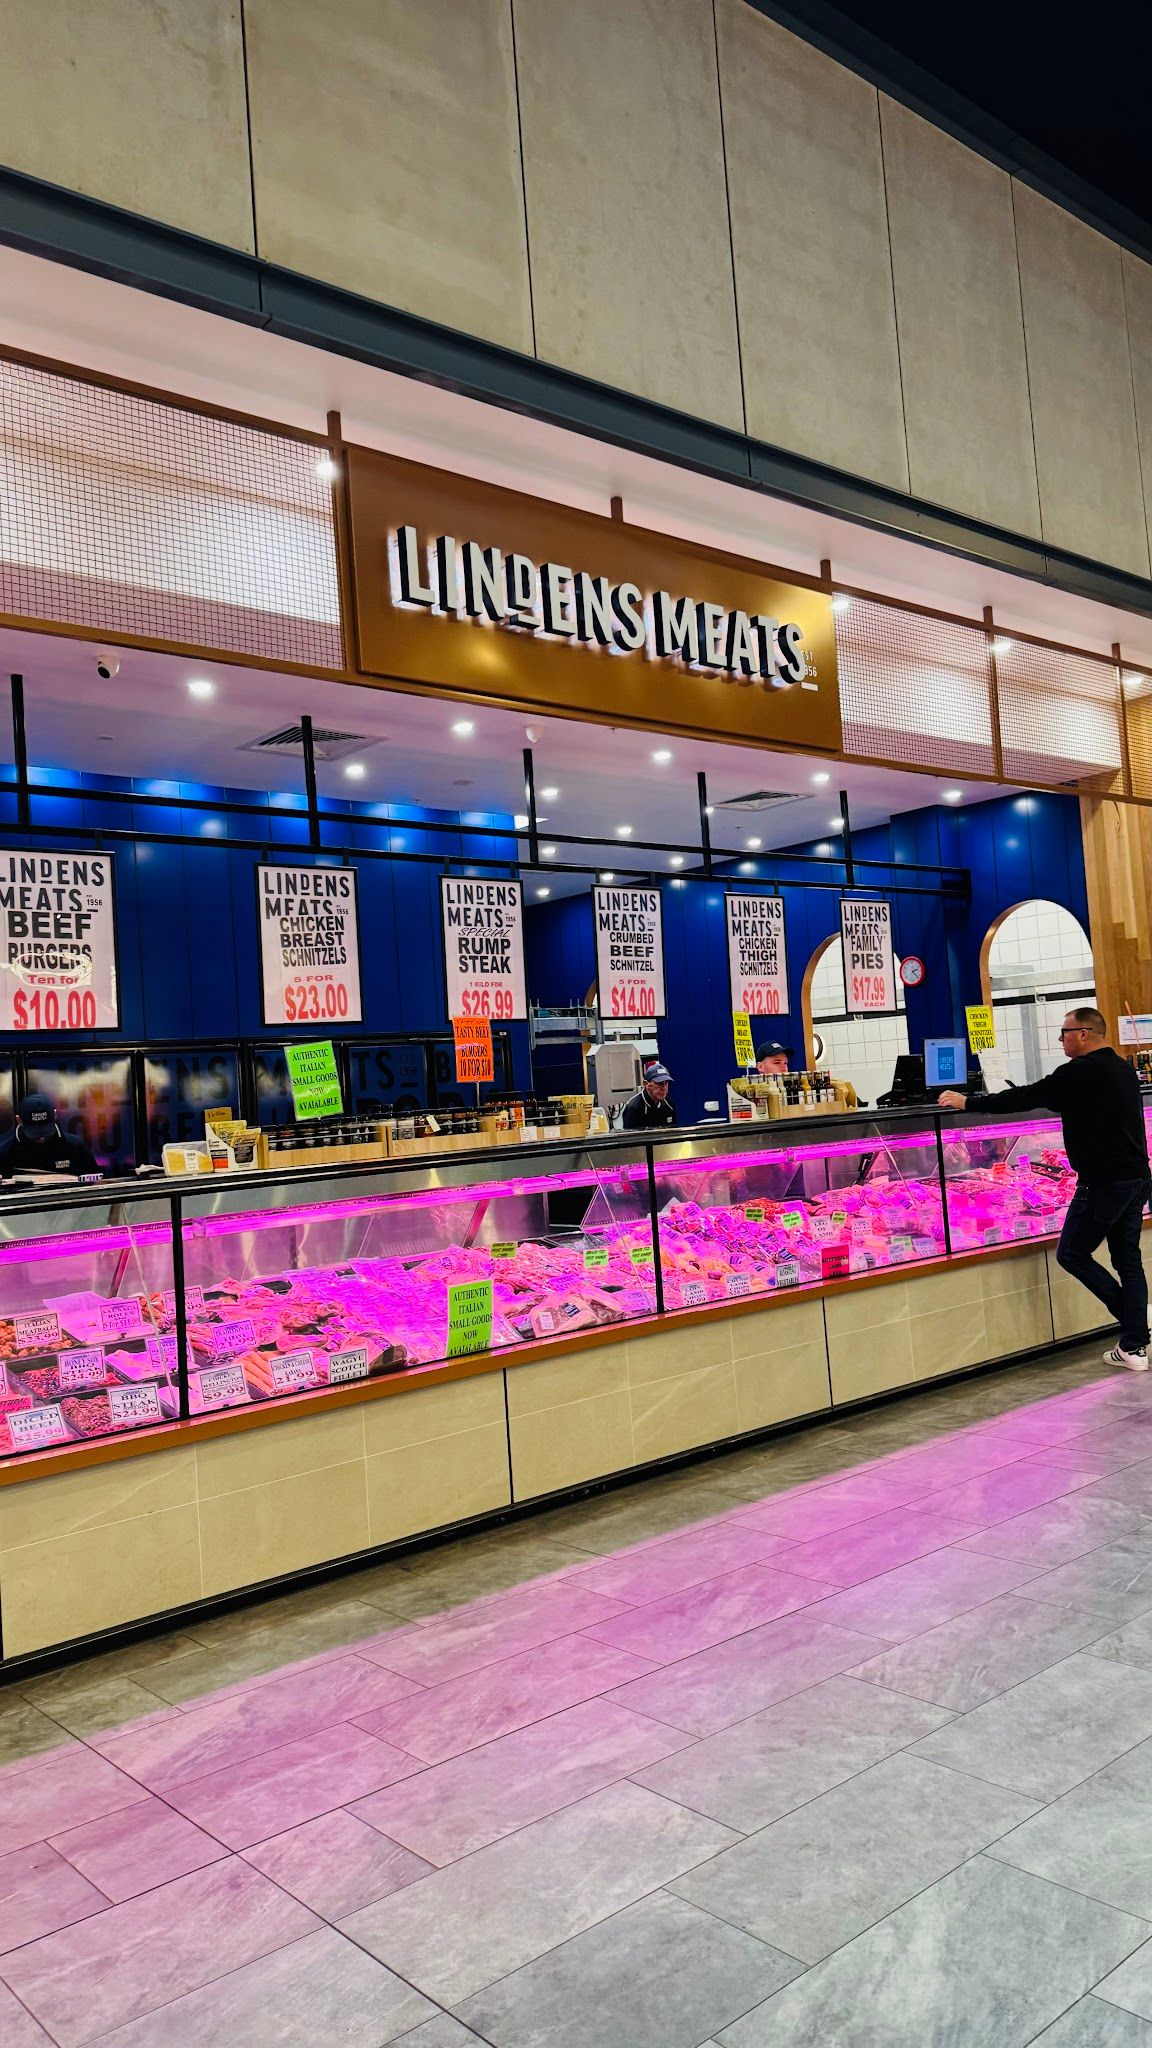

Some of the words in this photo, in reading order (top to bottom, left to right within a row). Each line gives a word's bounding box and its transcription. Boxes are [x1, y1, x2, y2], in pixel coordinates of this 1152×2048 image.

[397, 525, 646, 651] LINDENS
[653, 591, 805, 684] MEATS
[0, 857, 105, 887] INDENS
[264, 872, 350, 898] LINDENS
[446, 884, 517, 907] LINDENS
[598, 892, 657, 912] LINDENS
[265, 897, 333, 919] MEATS
[731, 900, 781, 918] LINDENS
[843, 905, 888, 922] LINDENS
[279, 916, 345, 932] CHICKEN
[447, 907, 504, 928] MEATS
[599, 913, 646, 932] MEATS
[7, 911, 92, 940] BEEF
[458, 928, 511, 937] SPECIAL
[732, 920, 772, 937] MEATS
[845, 923, 880, 939] MEATS
[280, 932, 345, 948] BREAST
[609, 932, 654, 944] CRUMBED
[738, 937, 777, 949] CHICKEN
[850, 935, 883, 951] FAMILY
[458, 937, 511, 955] RUMP
[610, 945, 655, 957] BEEF
[8, 942, 92, 970] BURGERS
[282, 947, 347, 967] SCHNITZELS
[739, 950, 777, 961] THIGH
[851, 953, 884, 969] PIES
[458, 955, 512, 974] STEAK
[610, 960, 655, 971] SCHNITZEL
[740, 962, 778, 976] SCHNITZELS
[27, 974, 56, 985] Ten
[853, 976, 885, 1003] $17.99
[284, 983, 348, 1022] $23.00
[461, 989, 514, 1019] $26.99
[611, 985, 655, 1017] $14.00
[742, 989, 780, 1014] $12.00
[13, 988, 97, 1030] $10.00
[455, 1026, 474, 1038] TASTY
[292, 1049, 329, 1061] AUTHENTIC
[461, 1045, 488, 1057] BURGERS
[300, 1061, 327, 1072] ITALIAN
[467, 1059, 480, 1076] FOR
[293, 1076, 315, 1086] SMALL
[316, 1072, 338, 1083] GOODS
[309, 1086, 325, 1096] NOW
[454, 1287, 489, 1301] AUTHENTIC
[459, 1302, 484, 1314] ITALIAN
[449, 1318, 471, 1330] SMALL
[472, 1313, 493, 1325] GOODS
[19, 1325, 58, 1336] MEATBALLS
[463, 1330, 478, 1340] NOW
[331, 1363, 365, 1374] SCOTCH
[332, 1355, 363, 1367] WAGYU
[203, 1376, 243, 1387] WELLINGTON
[208, 1372, 236, 1381] CHICKEN
[276, 1371, 314, 1384] 21.99
[333, 1371, 363, 1382] FILLET
[203, 1386, 244, 1400] $9.99
[113, 1399, 156, 1409] STEAK
[13, 1412, 59, 1426] DICED
[114, 1407, 157, 1418] $24.99
[19, 1419, 57, 1432] BEEF
[14, 1428, 61, 1443] $25.99
